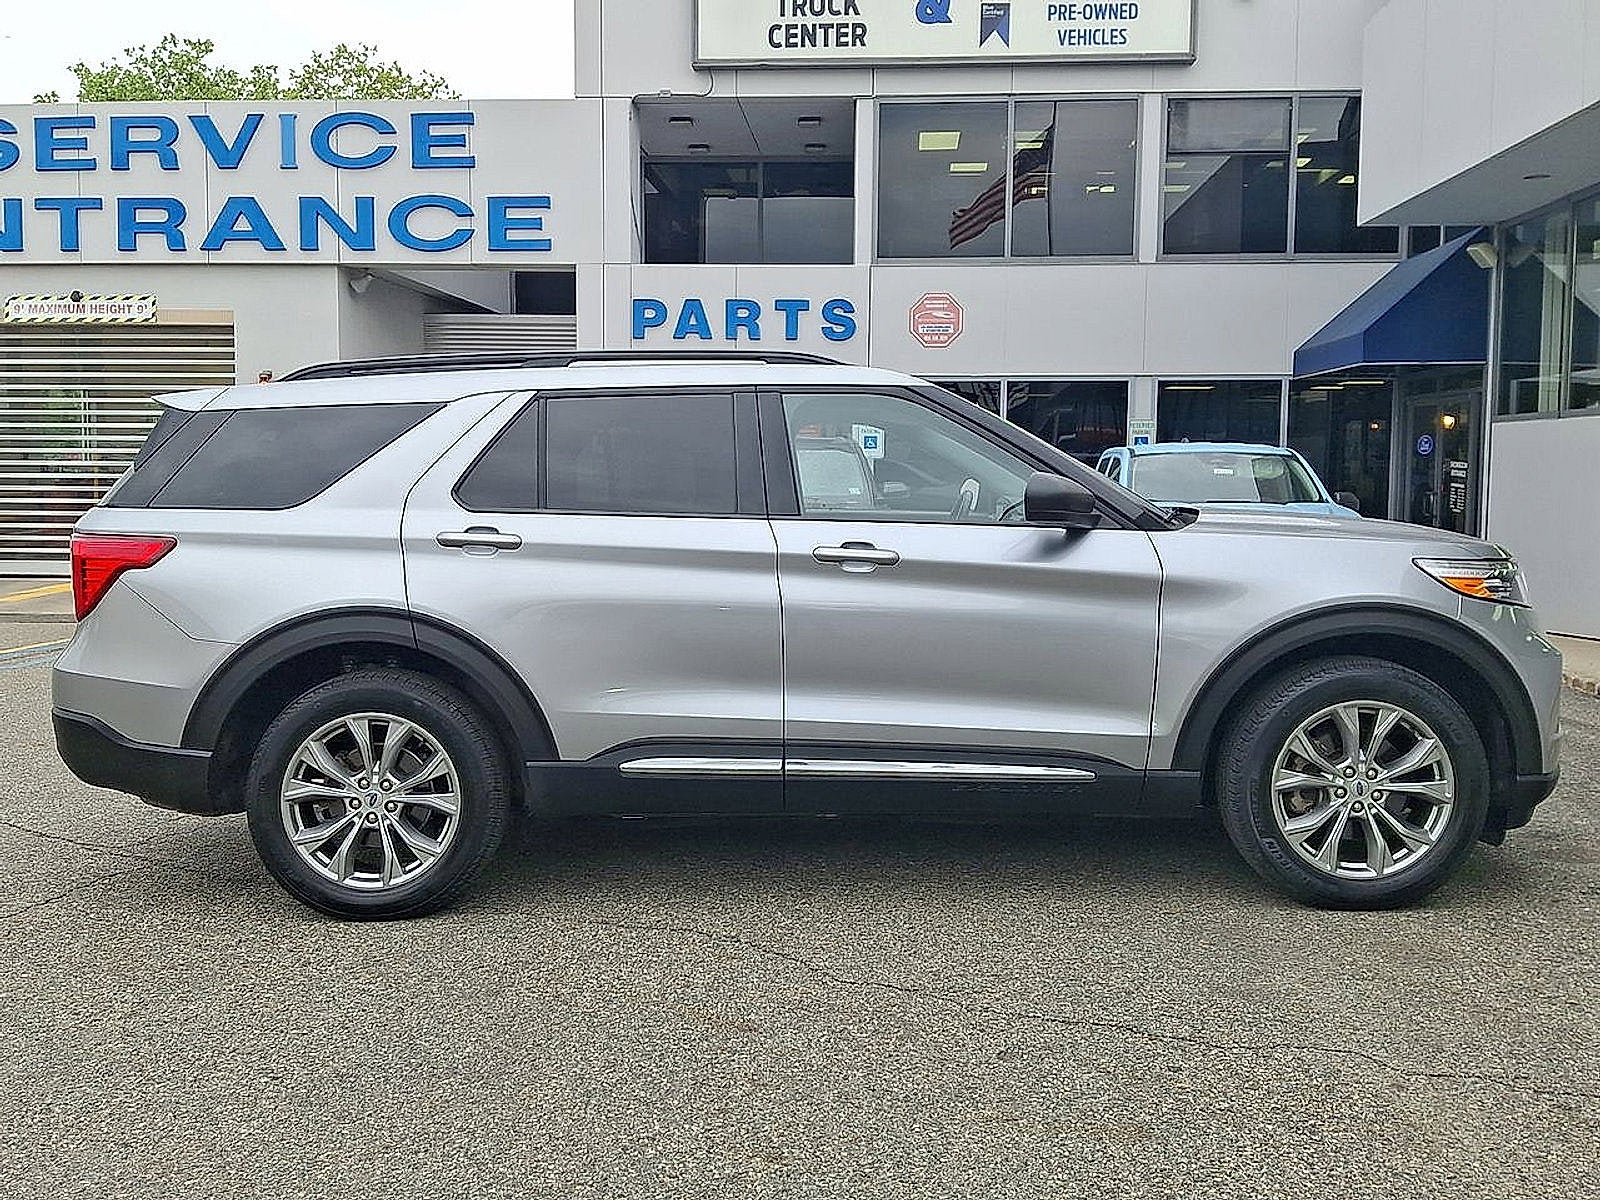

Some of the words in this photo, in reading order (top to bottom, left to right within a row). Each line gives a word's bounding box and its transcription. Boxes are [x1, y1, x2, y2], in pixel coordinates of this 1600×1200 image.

[777, 0, 861, 17] TRUCK
[1047, 3, 1139, 21] PRE-OWNED
[768, 23, 867, 48] CENTER
[1057, 28, 1128, 46] VEHICLES
[0, 194, 553, 253] TRANCE
[28, 303, 86, 314] MAXIMUM
[89, 303, 133, 314] HEIGHT
[632, 298, 857, 342] PARTS
